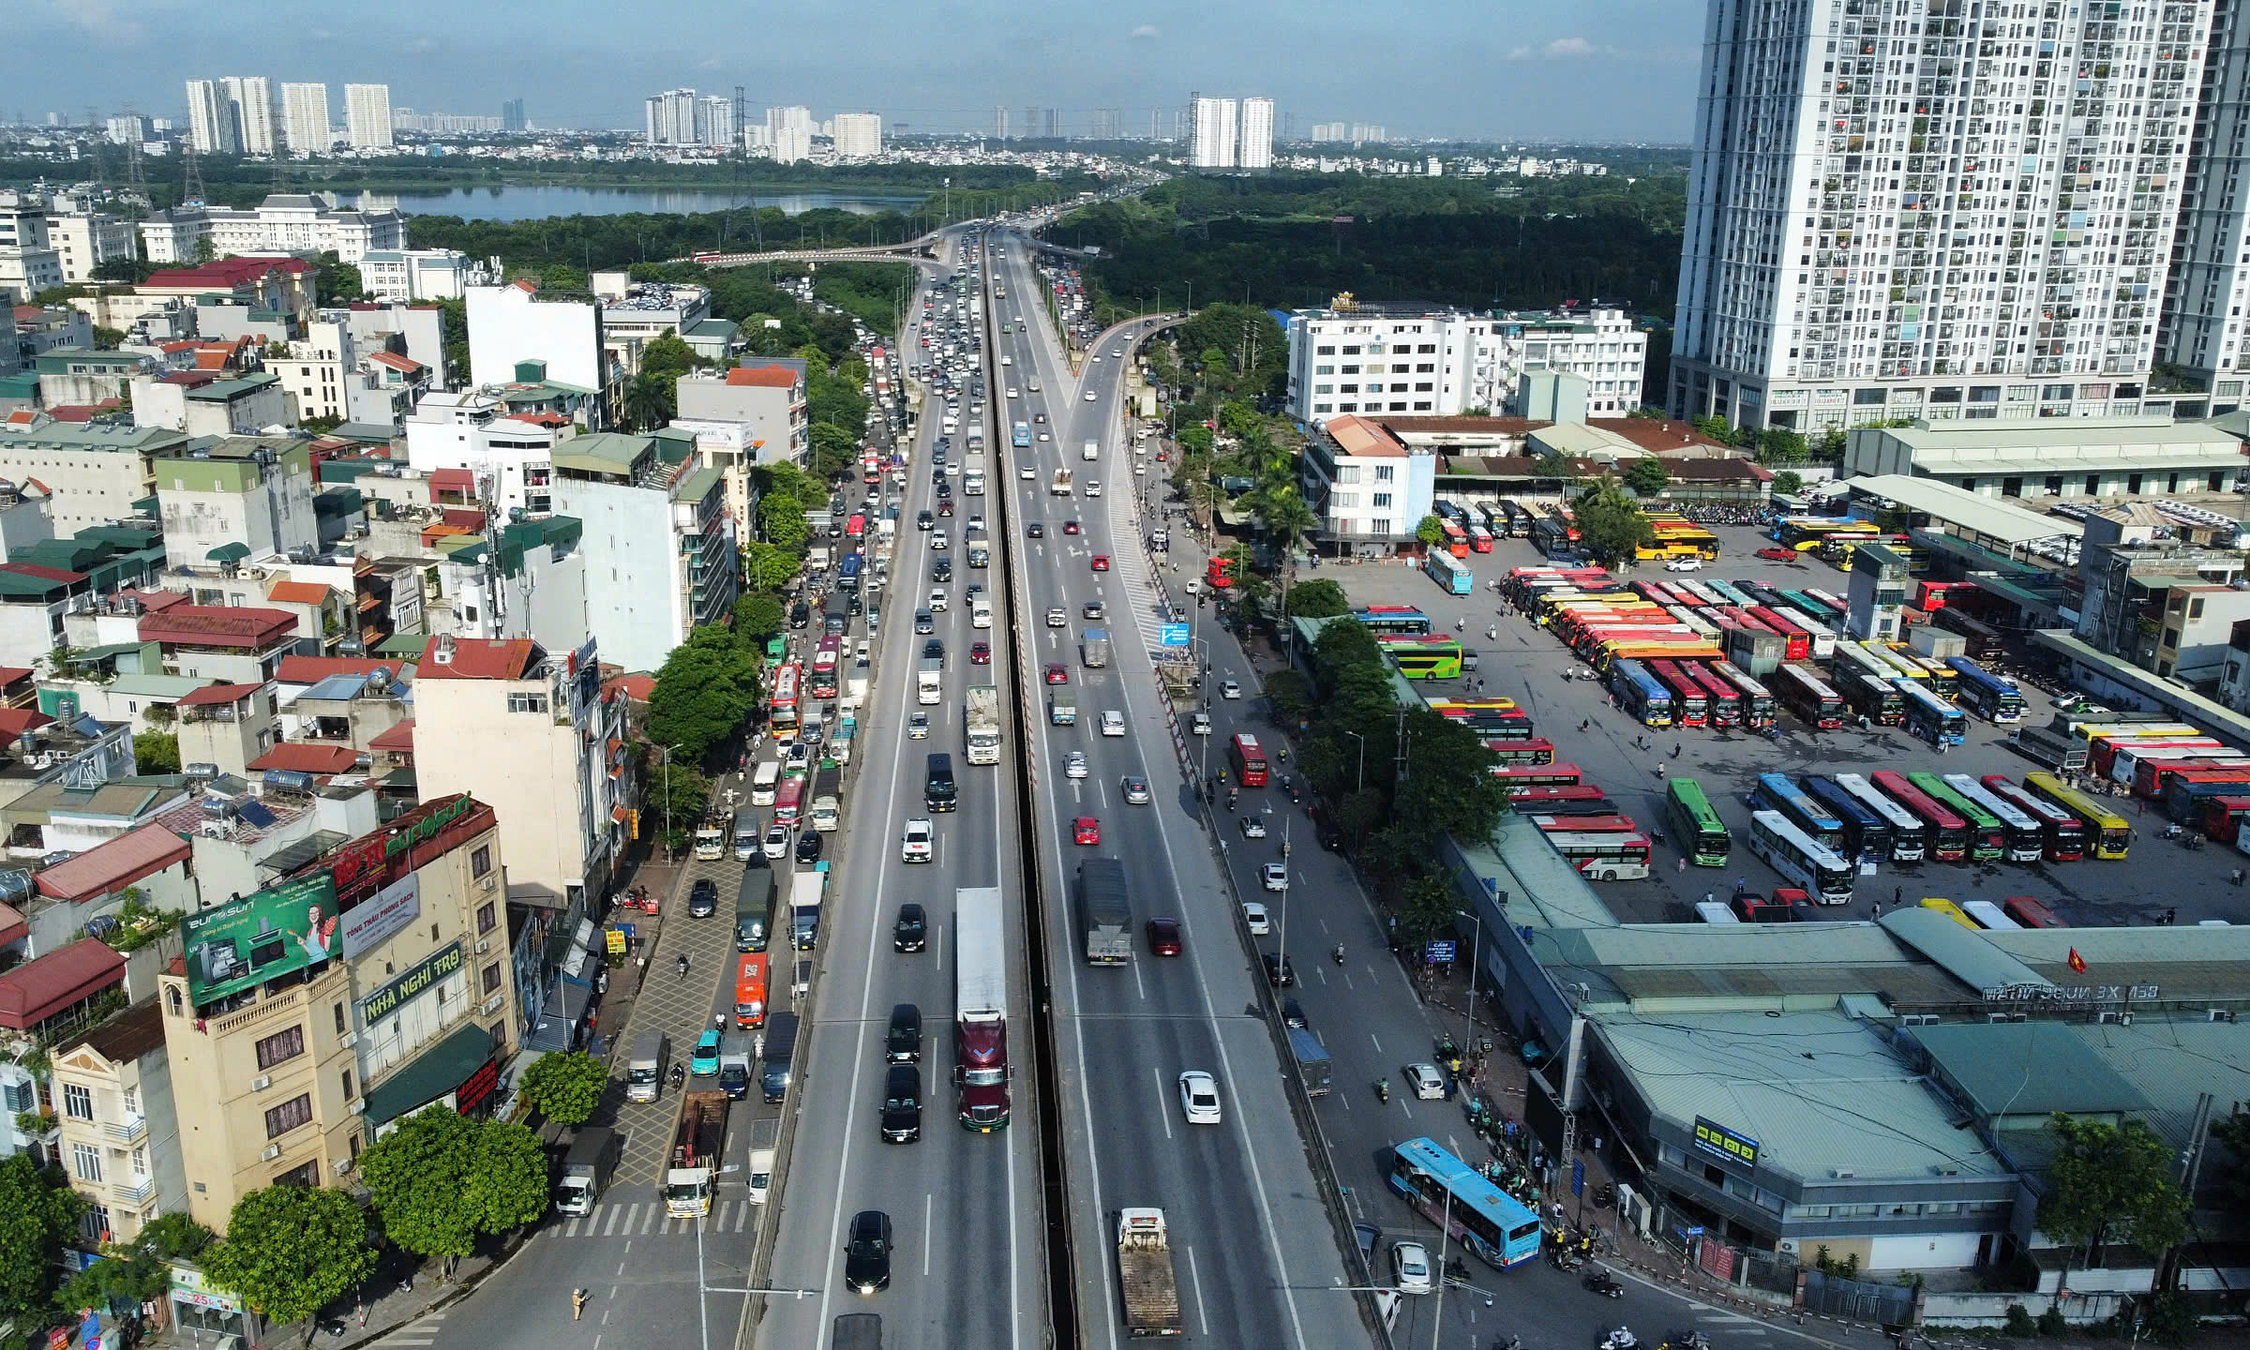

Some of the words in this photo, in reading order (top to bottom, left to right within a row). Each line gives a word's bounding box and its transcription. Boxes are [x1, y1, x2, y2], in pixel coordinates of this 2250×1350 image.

[187, 900, 255, 930] eurosun
[367, 988, 396, 1021] NHÀ
[399, 962, 432, 999] NGHỈ
[434, 948, 461, 976] TRỌ
[1727, 1142, 1737, 1151] C1
